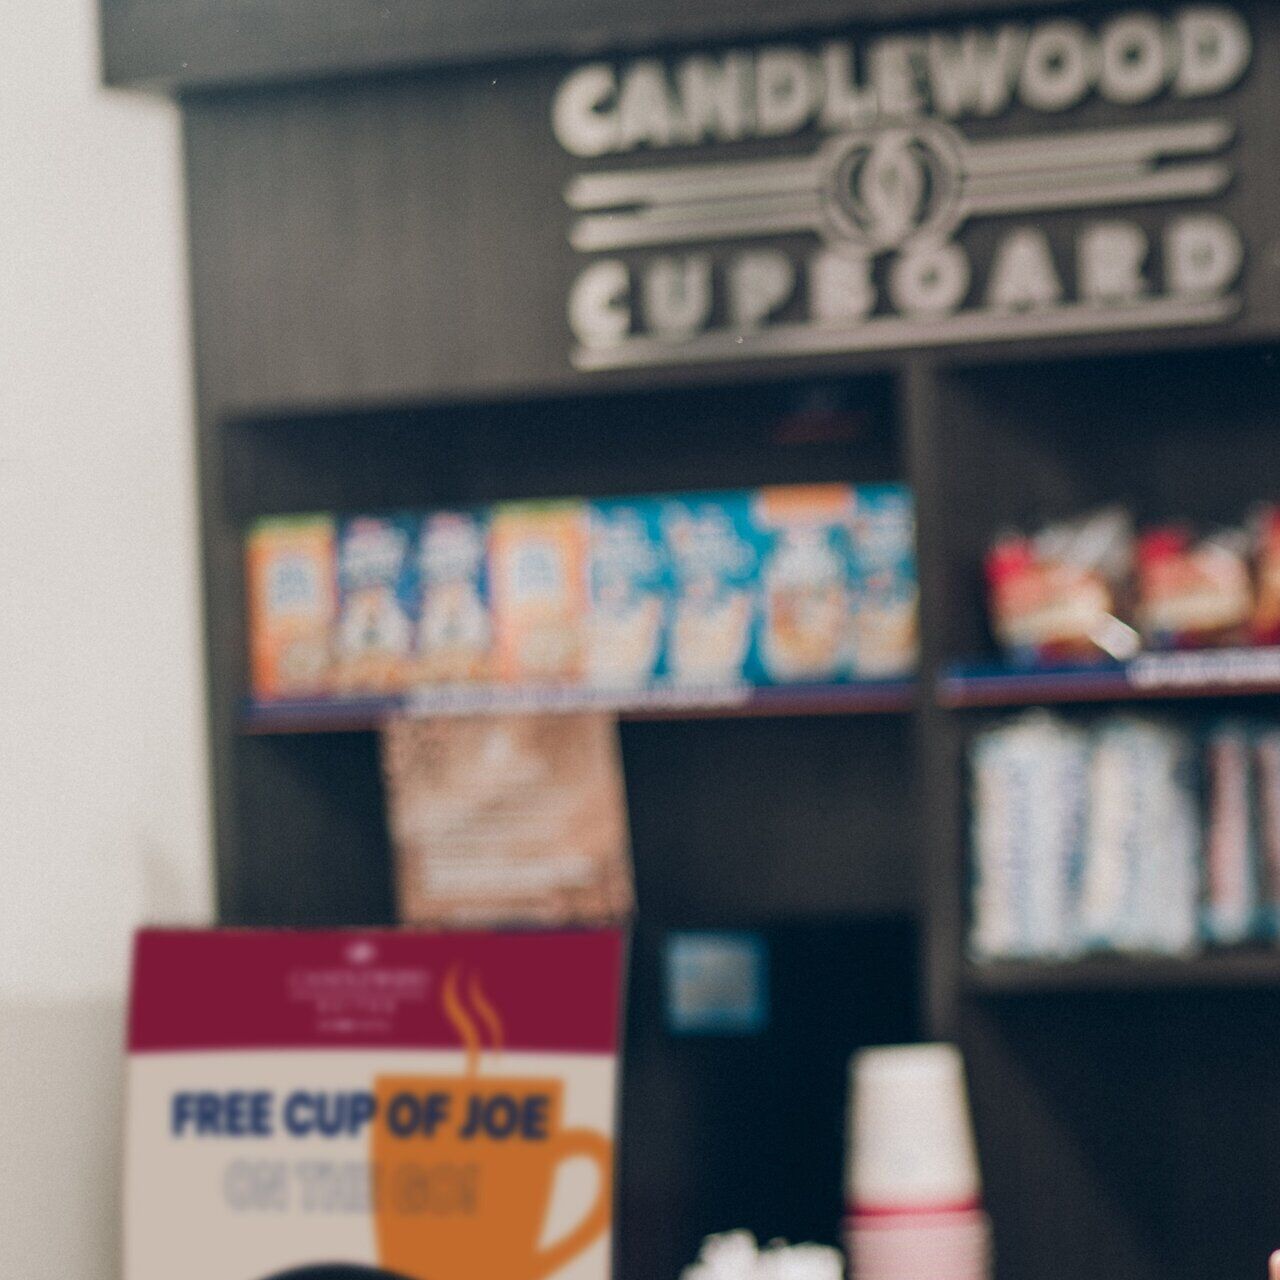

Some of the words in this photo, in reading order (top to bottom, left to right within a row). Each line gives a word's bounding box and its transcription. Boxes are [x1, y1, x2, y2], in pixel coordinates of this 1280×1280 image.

[553, 5, 1251, 157] CANDLEWOOD
[568, 212, 1243, 350] CUPBOARD
[171, 1090, 273, 1138] FREE
[283, 1090, 376, 1138] CUP
[387, 1090, 452, 1139] OF
[459, 1091, 551, 1141] JOE
